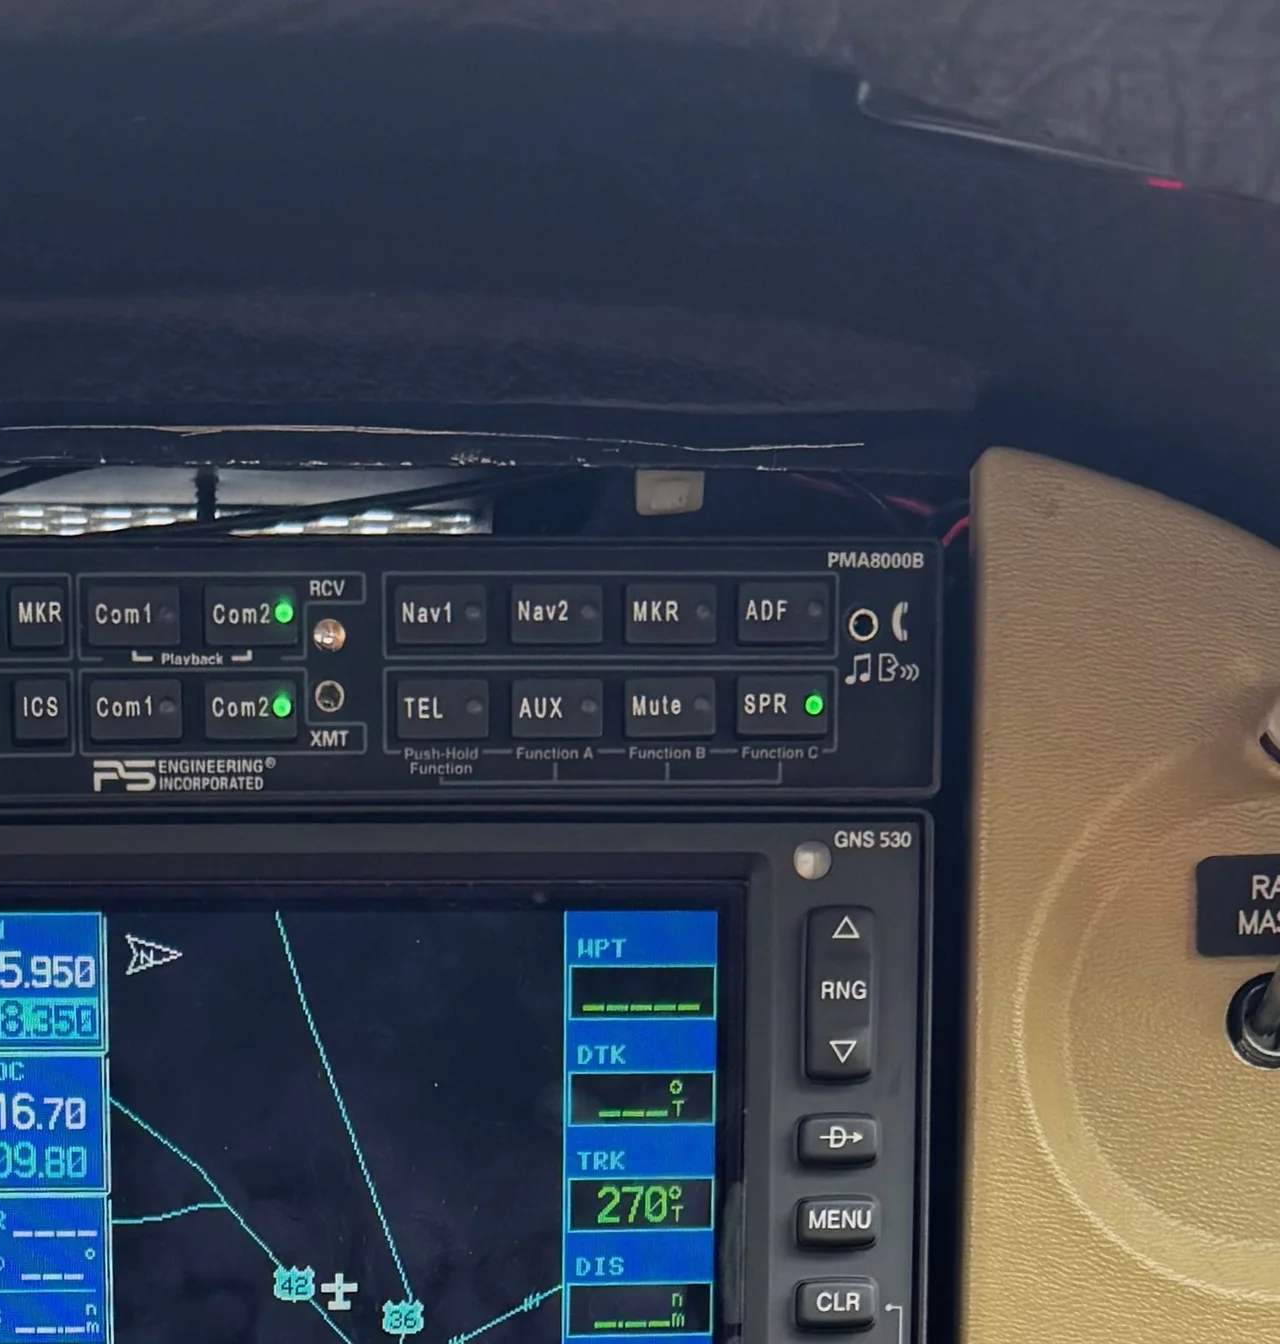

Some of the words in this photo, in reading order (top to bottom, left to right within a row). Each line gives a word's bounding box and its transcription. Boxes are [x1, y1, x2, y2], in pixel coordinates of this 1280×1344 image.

[828, 552, 924, 569] PMA8000B
[310, 581, 345, 597] RCV
[19, 602, 62, 624] MKR
[95, 604, 152, 625] Com1
[213, 604, 270, 625] Com2
[402, 604, 453, 623] Nav1
[518, 602, 568, 622] Nav2
[633, 602, 678, 622] MKR
[746, 601, 787, 621] ADF
[162, 652, 223, 667] Playback
[23, 697, 58, 718] ICS
[96, 697, 152, 716] Com1
[212, 697, 270, 717] Com2
[404, 699, 443, 719] TEL
[520, 698, 562, 718] AUX
[632, 696, 681, 716] Mute
[744, 694, 787, 714] SPR
[310, 732, 348, 748] XMT
[158, 760, 262, 774] ENGINEERING
[158, 777, 263, 792] INCORPORATED
[834, 832, 874, 848] GNS
[880, 832, 911, 848] 530
[821, 982, 866, 1000] RNG
[808, 1210, 872, 1229] MENU
[816, 1292, 860, 1311] CLR
